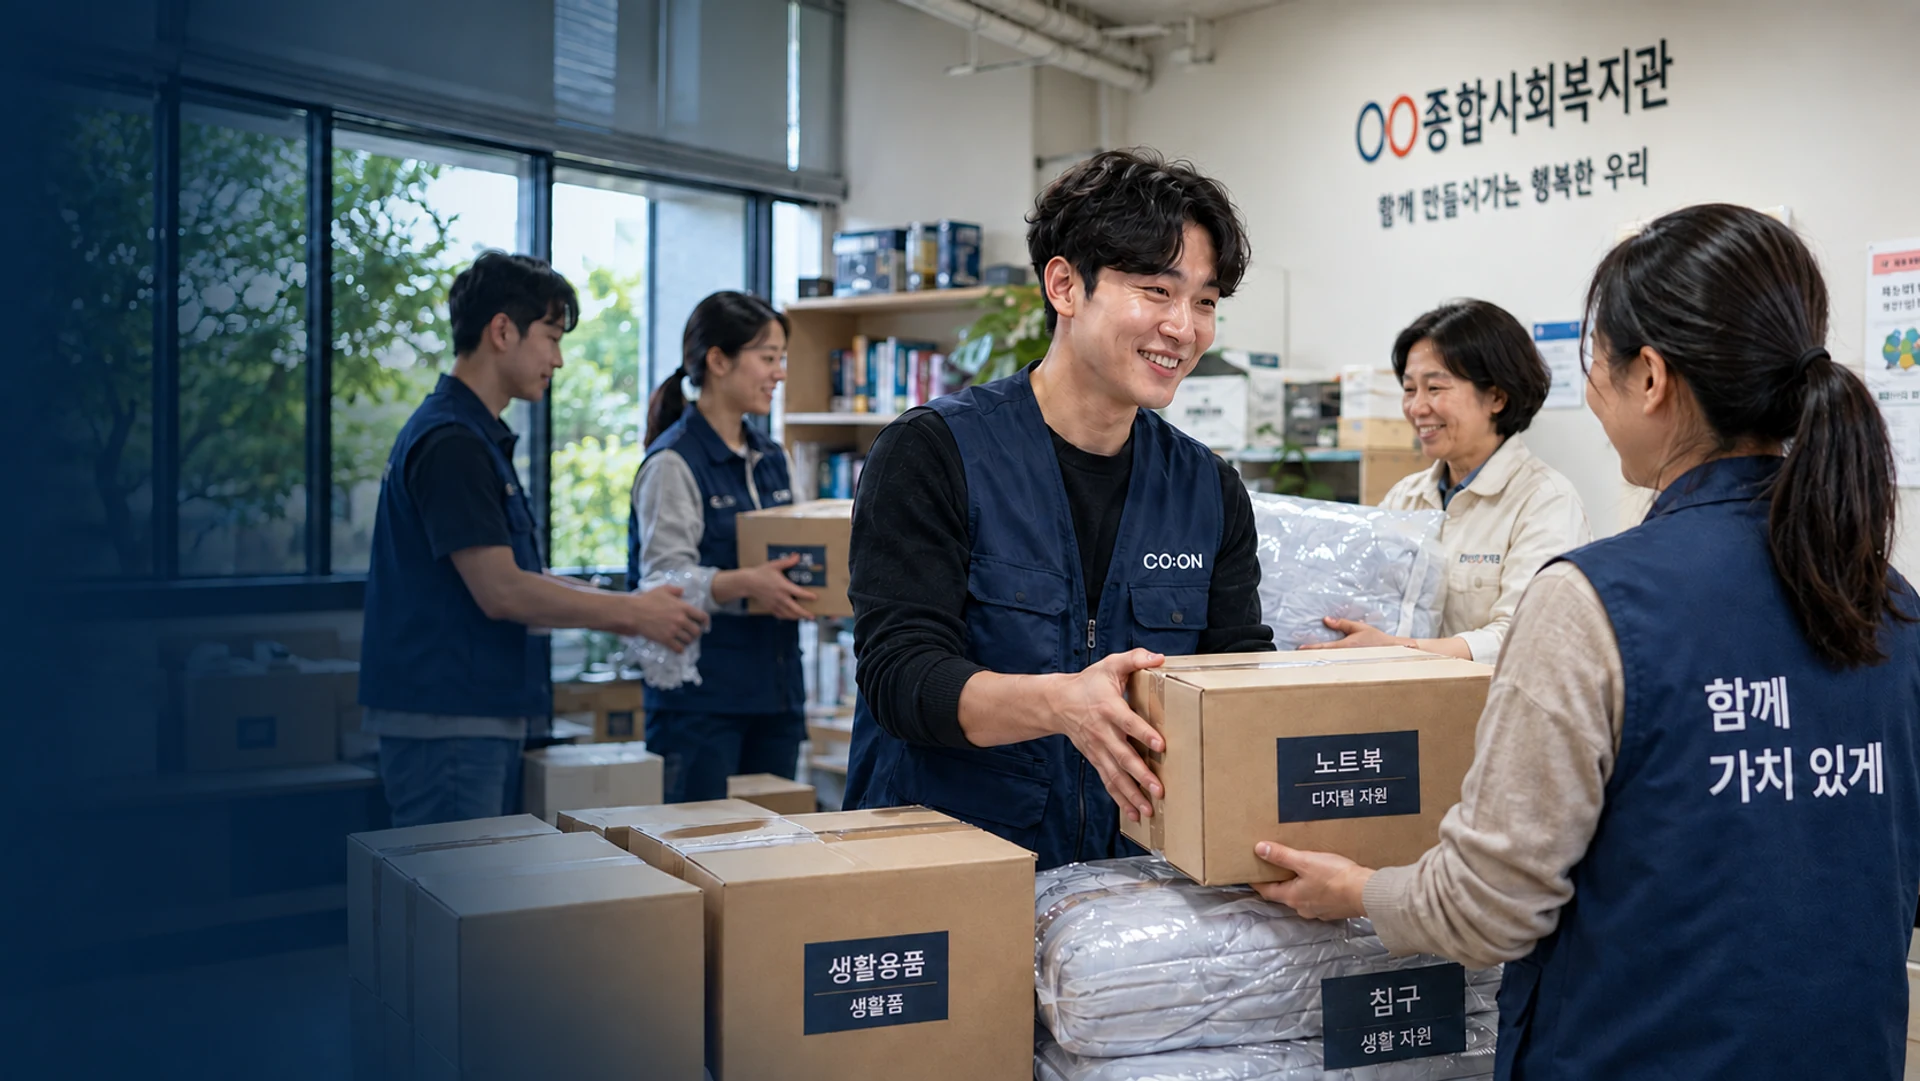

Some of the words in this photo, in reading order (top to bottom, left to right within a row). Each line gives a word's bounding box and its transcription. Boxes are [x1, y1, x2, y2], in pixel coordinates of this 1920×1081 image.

[1422, 172, 1521, 221] 만들어가는
[1531, 157, 1595, 203] 행복한
[1603, 147, 1648, 190] 우리
[1143, 553, 1203, 569] CO:ON
[1704, 676, 1790, 732] 함께
[1314, 747, 1383, 774] 노트북
[1709, 747, 1794, 803] 가치
[1809, 742, 1884, 798] 있게
[1359, 787, 1388, 805] 자원
[828, 950, 926, 984] 생활용품
[1370, 985, 1421, 1017] 침구
[1361, 1030, 1395, 1054] 생활
[1400, 1026, 1432, 1047] 자원
